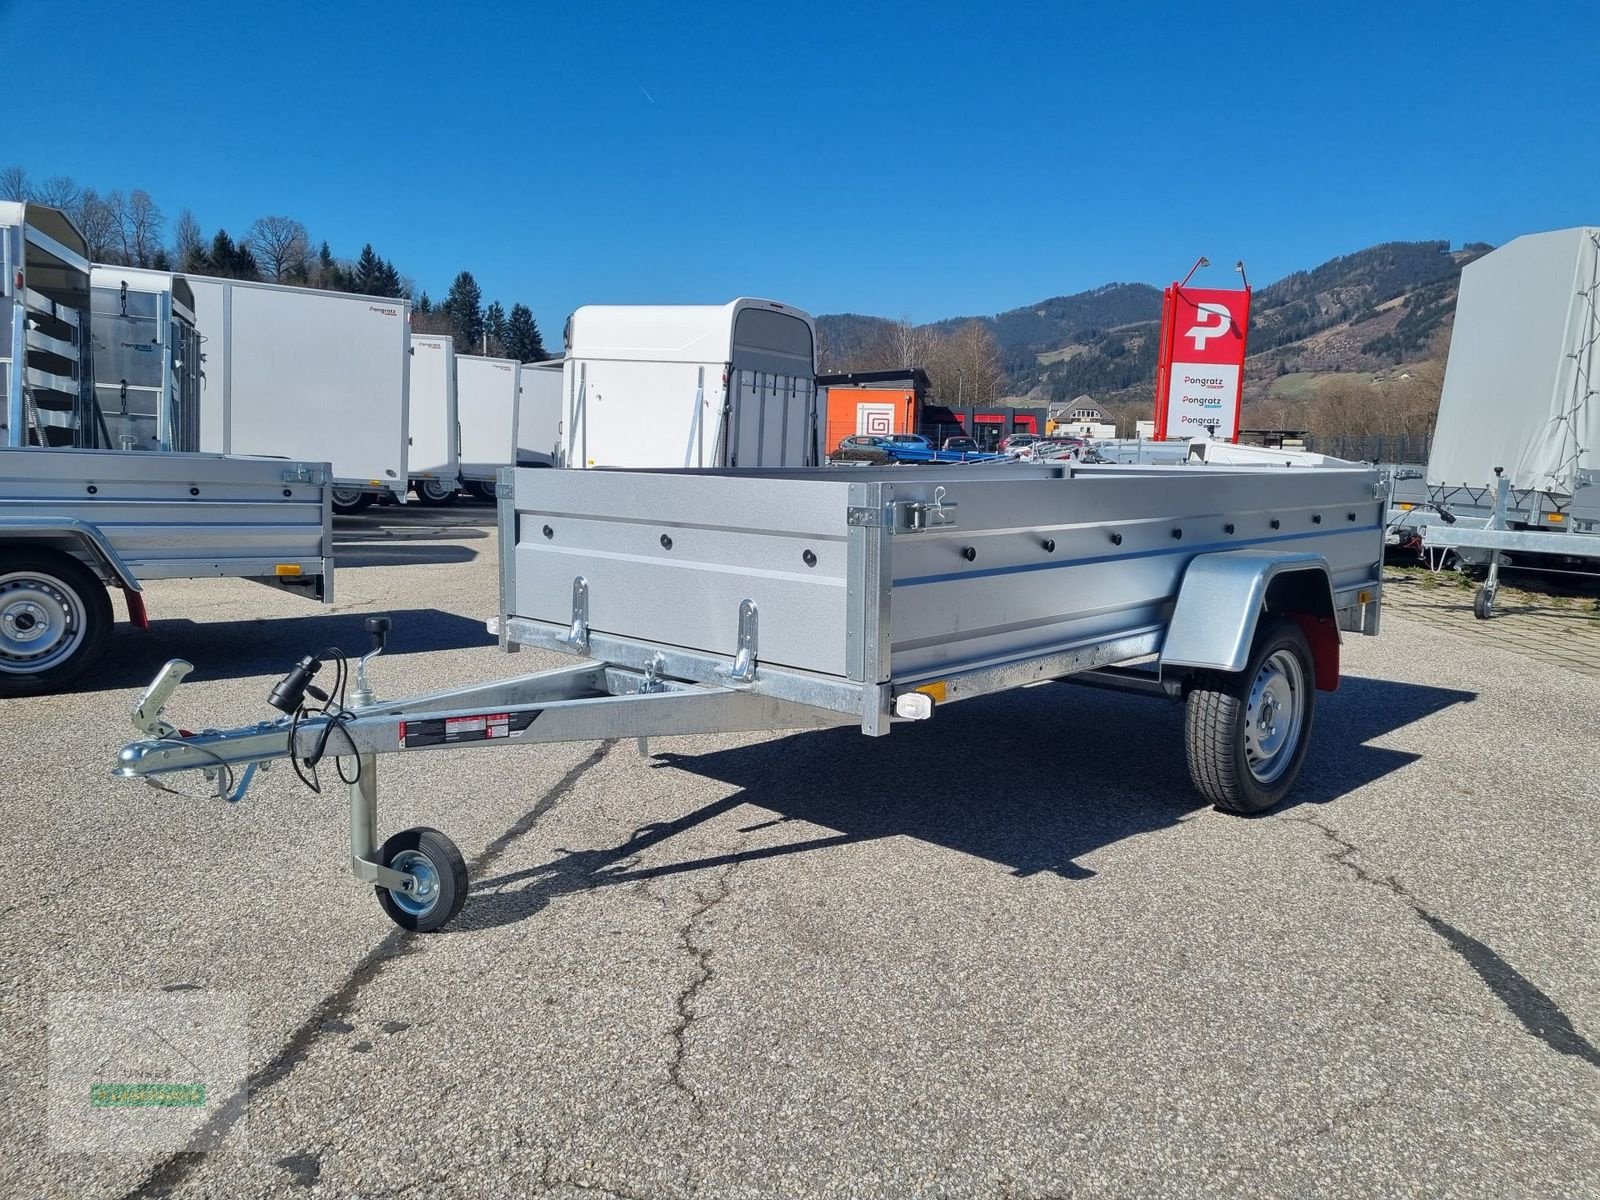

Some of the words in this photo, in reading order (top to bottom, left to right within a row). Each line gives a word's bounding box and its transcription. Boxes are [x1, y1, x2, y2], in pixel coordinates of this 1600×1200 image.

[1184, 376, 1223, 387] Pongratz
[1182, 395, 1221, 406] Pongratz
[1181, 415, 1220, 426] Pongratz
